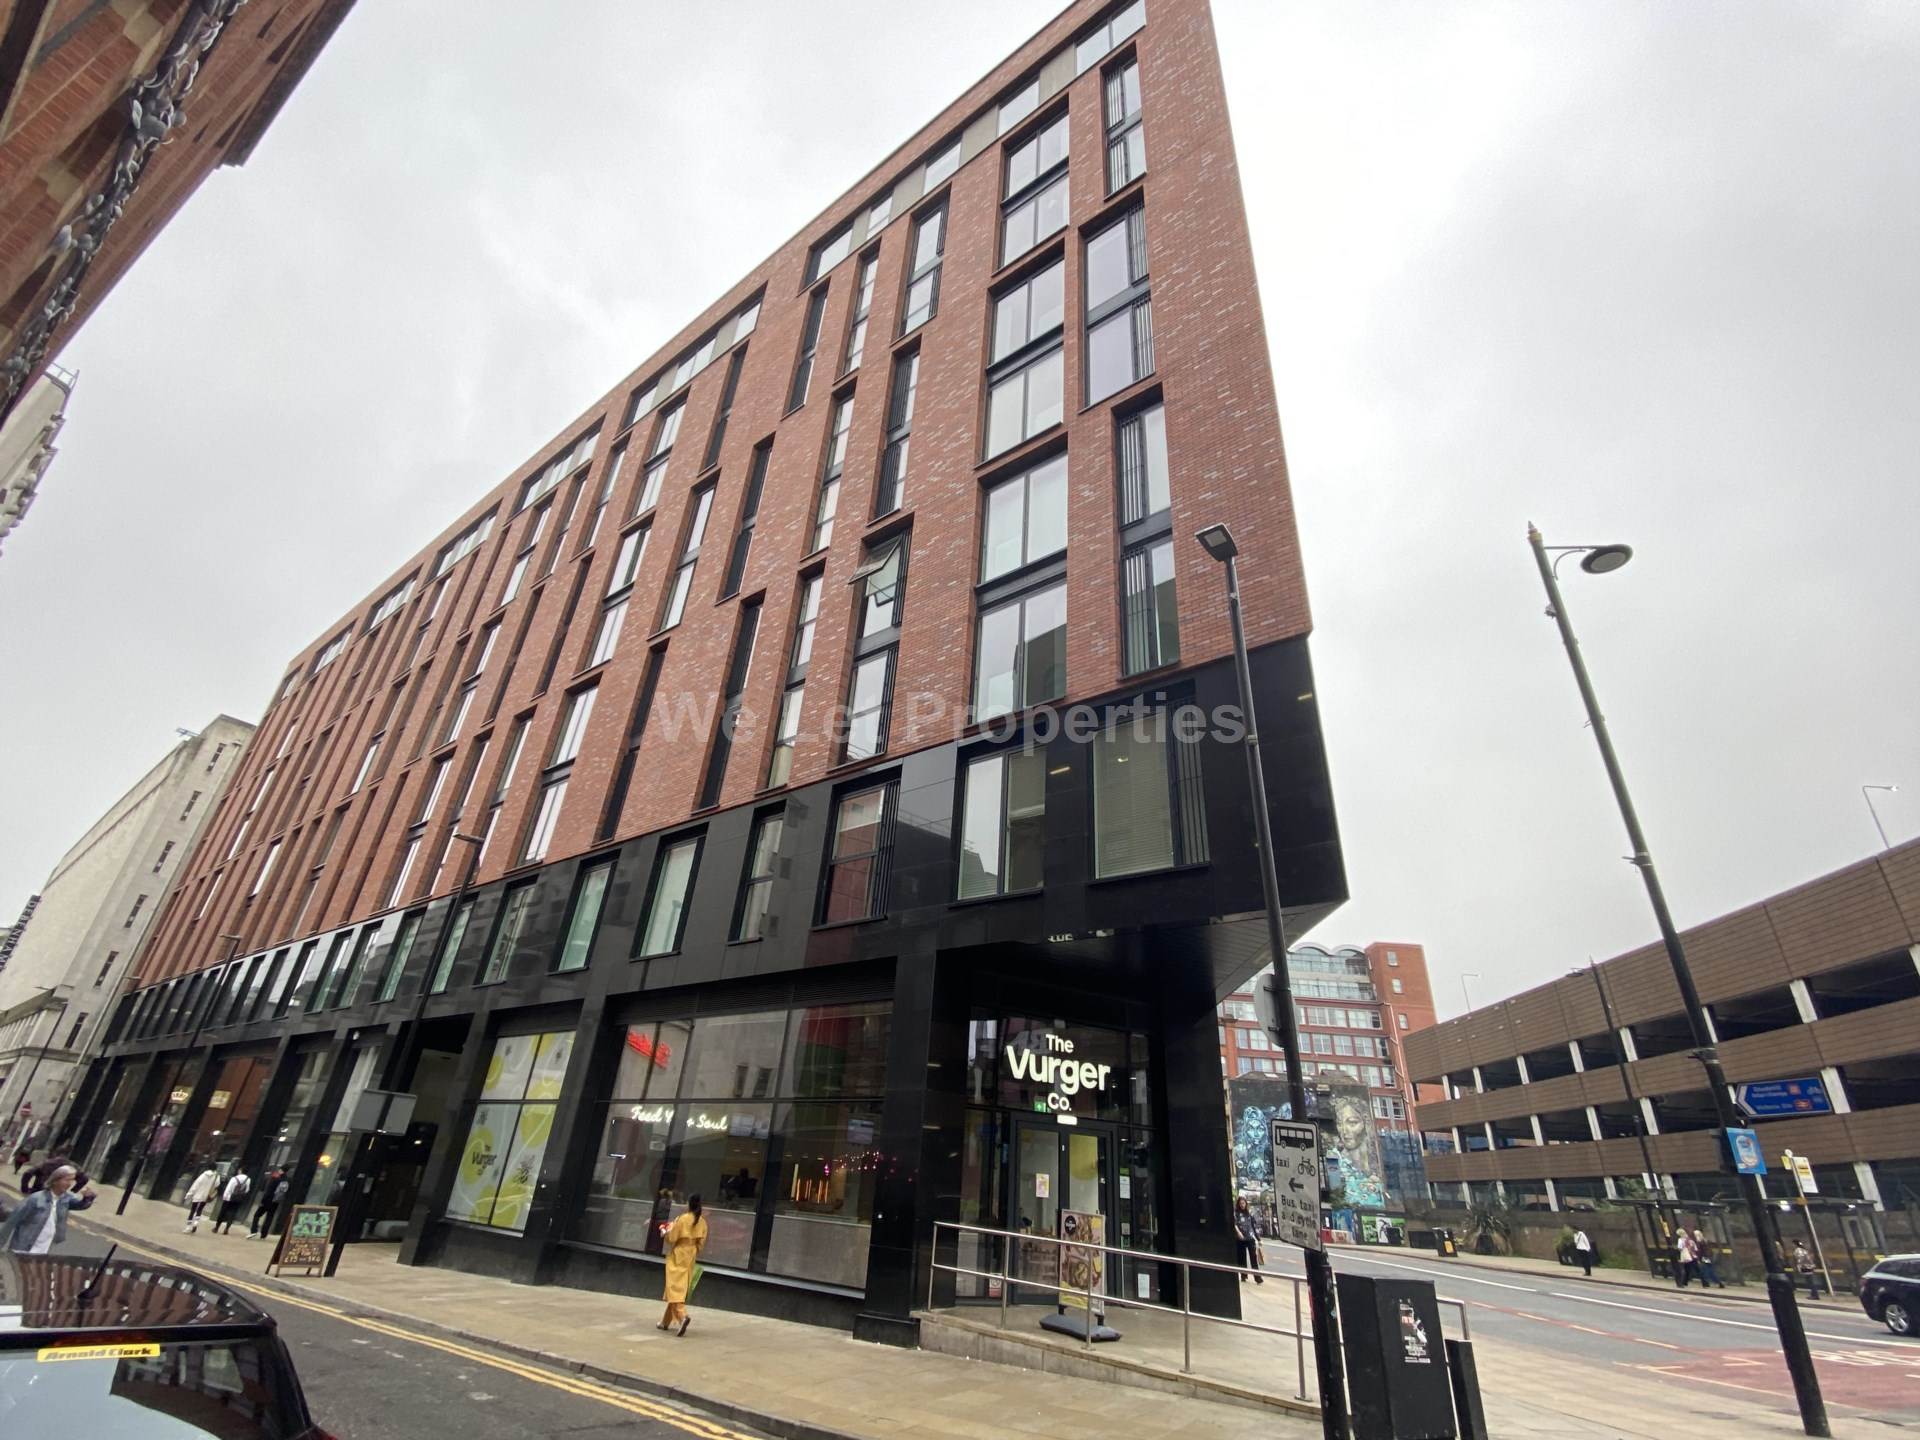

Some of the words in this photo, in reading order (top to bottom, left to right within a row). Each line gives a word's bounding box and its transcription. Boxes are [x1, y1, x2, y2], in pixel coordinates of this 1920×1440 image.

[1045, 1033, 1075, 1053] The
[1006, 1045, 1111, 1095] Vurger
[1047, 1092, 1072, 1111] Co.
[695, 1114, 728, 1131] Soul
[1276, 1156, 1290, 1168] taxi
[292, 1223, 330, 1238] SALE
[45, 1350, 106, 1360] Arnold
[108, 1347, 152, 1357] Clark
